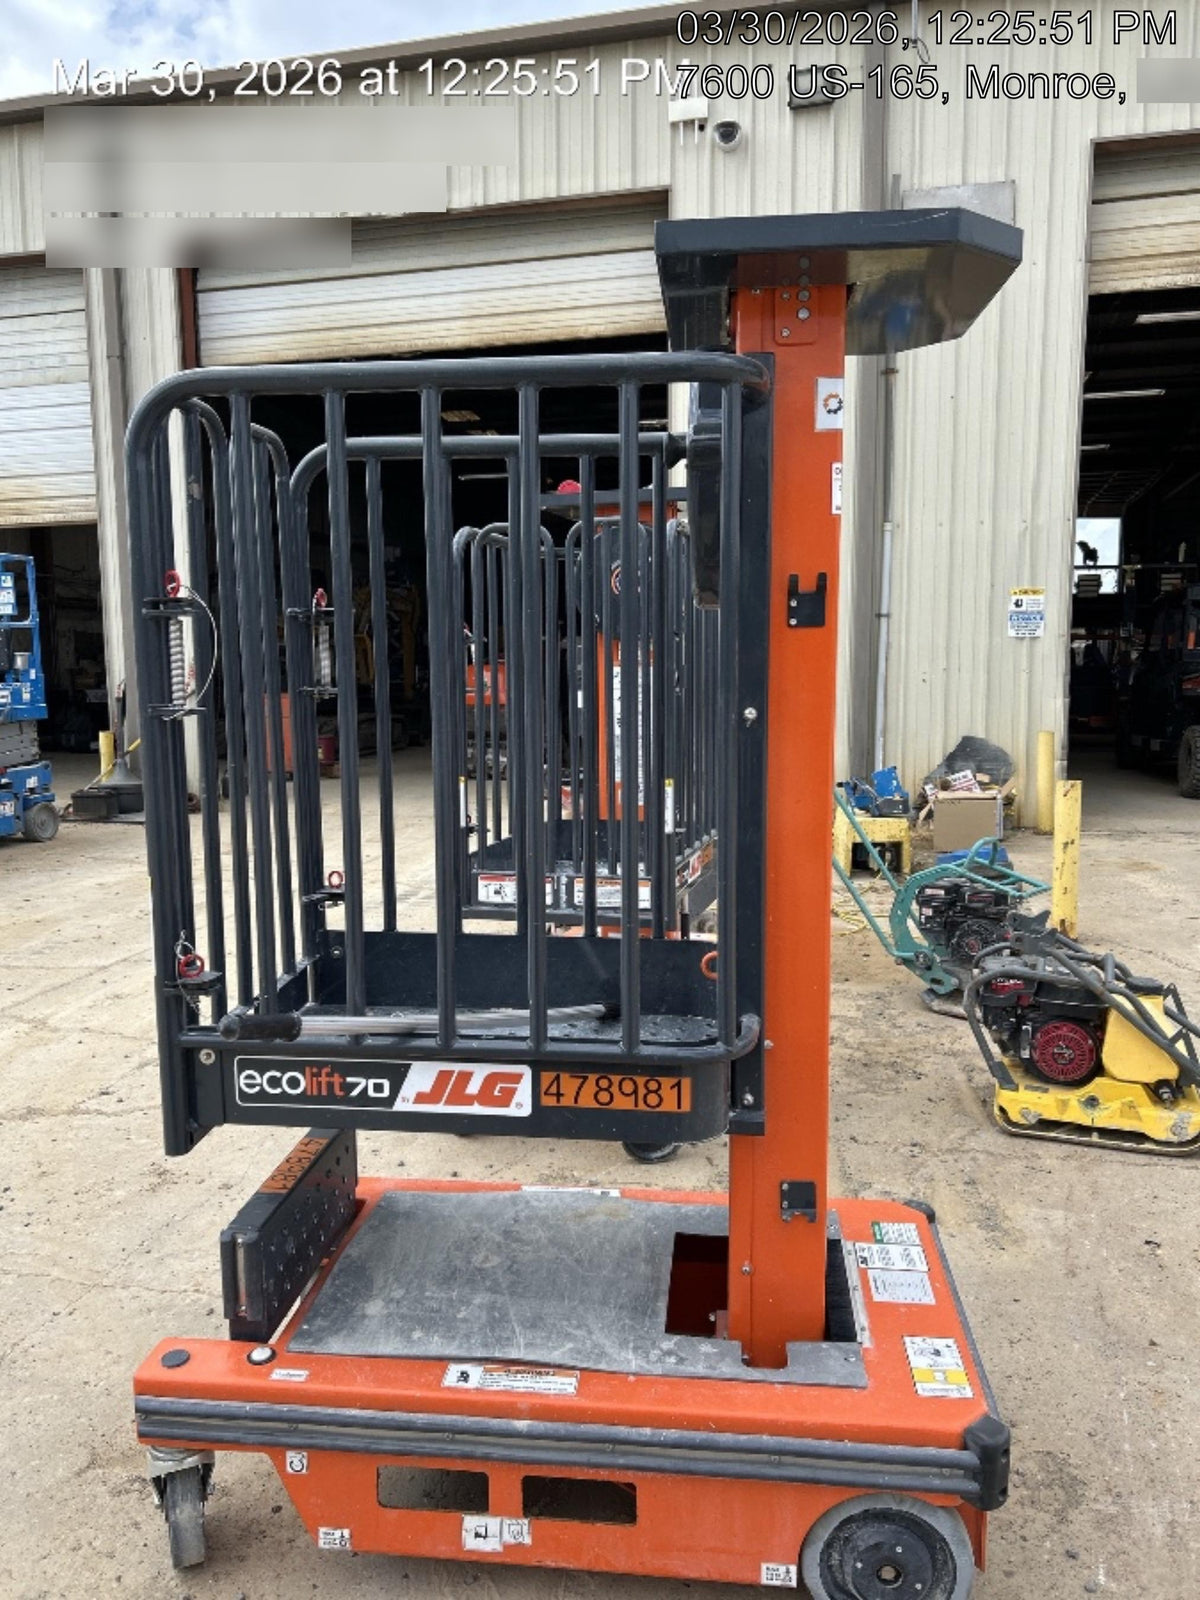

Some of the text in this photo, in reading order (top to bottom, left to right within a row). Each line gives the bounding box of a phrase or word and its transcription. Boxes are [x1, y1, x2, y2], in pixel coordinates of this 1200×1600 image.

[239, 1065, 390, 1098] ecolift70
[412, 1070, 525, 1108] JLG
[543, 1073, 683, 1110] 478981
